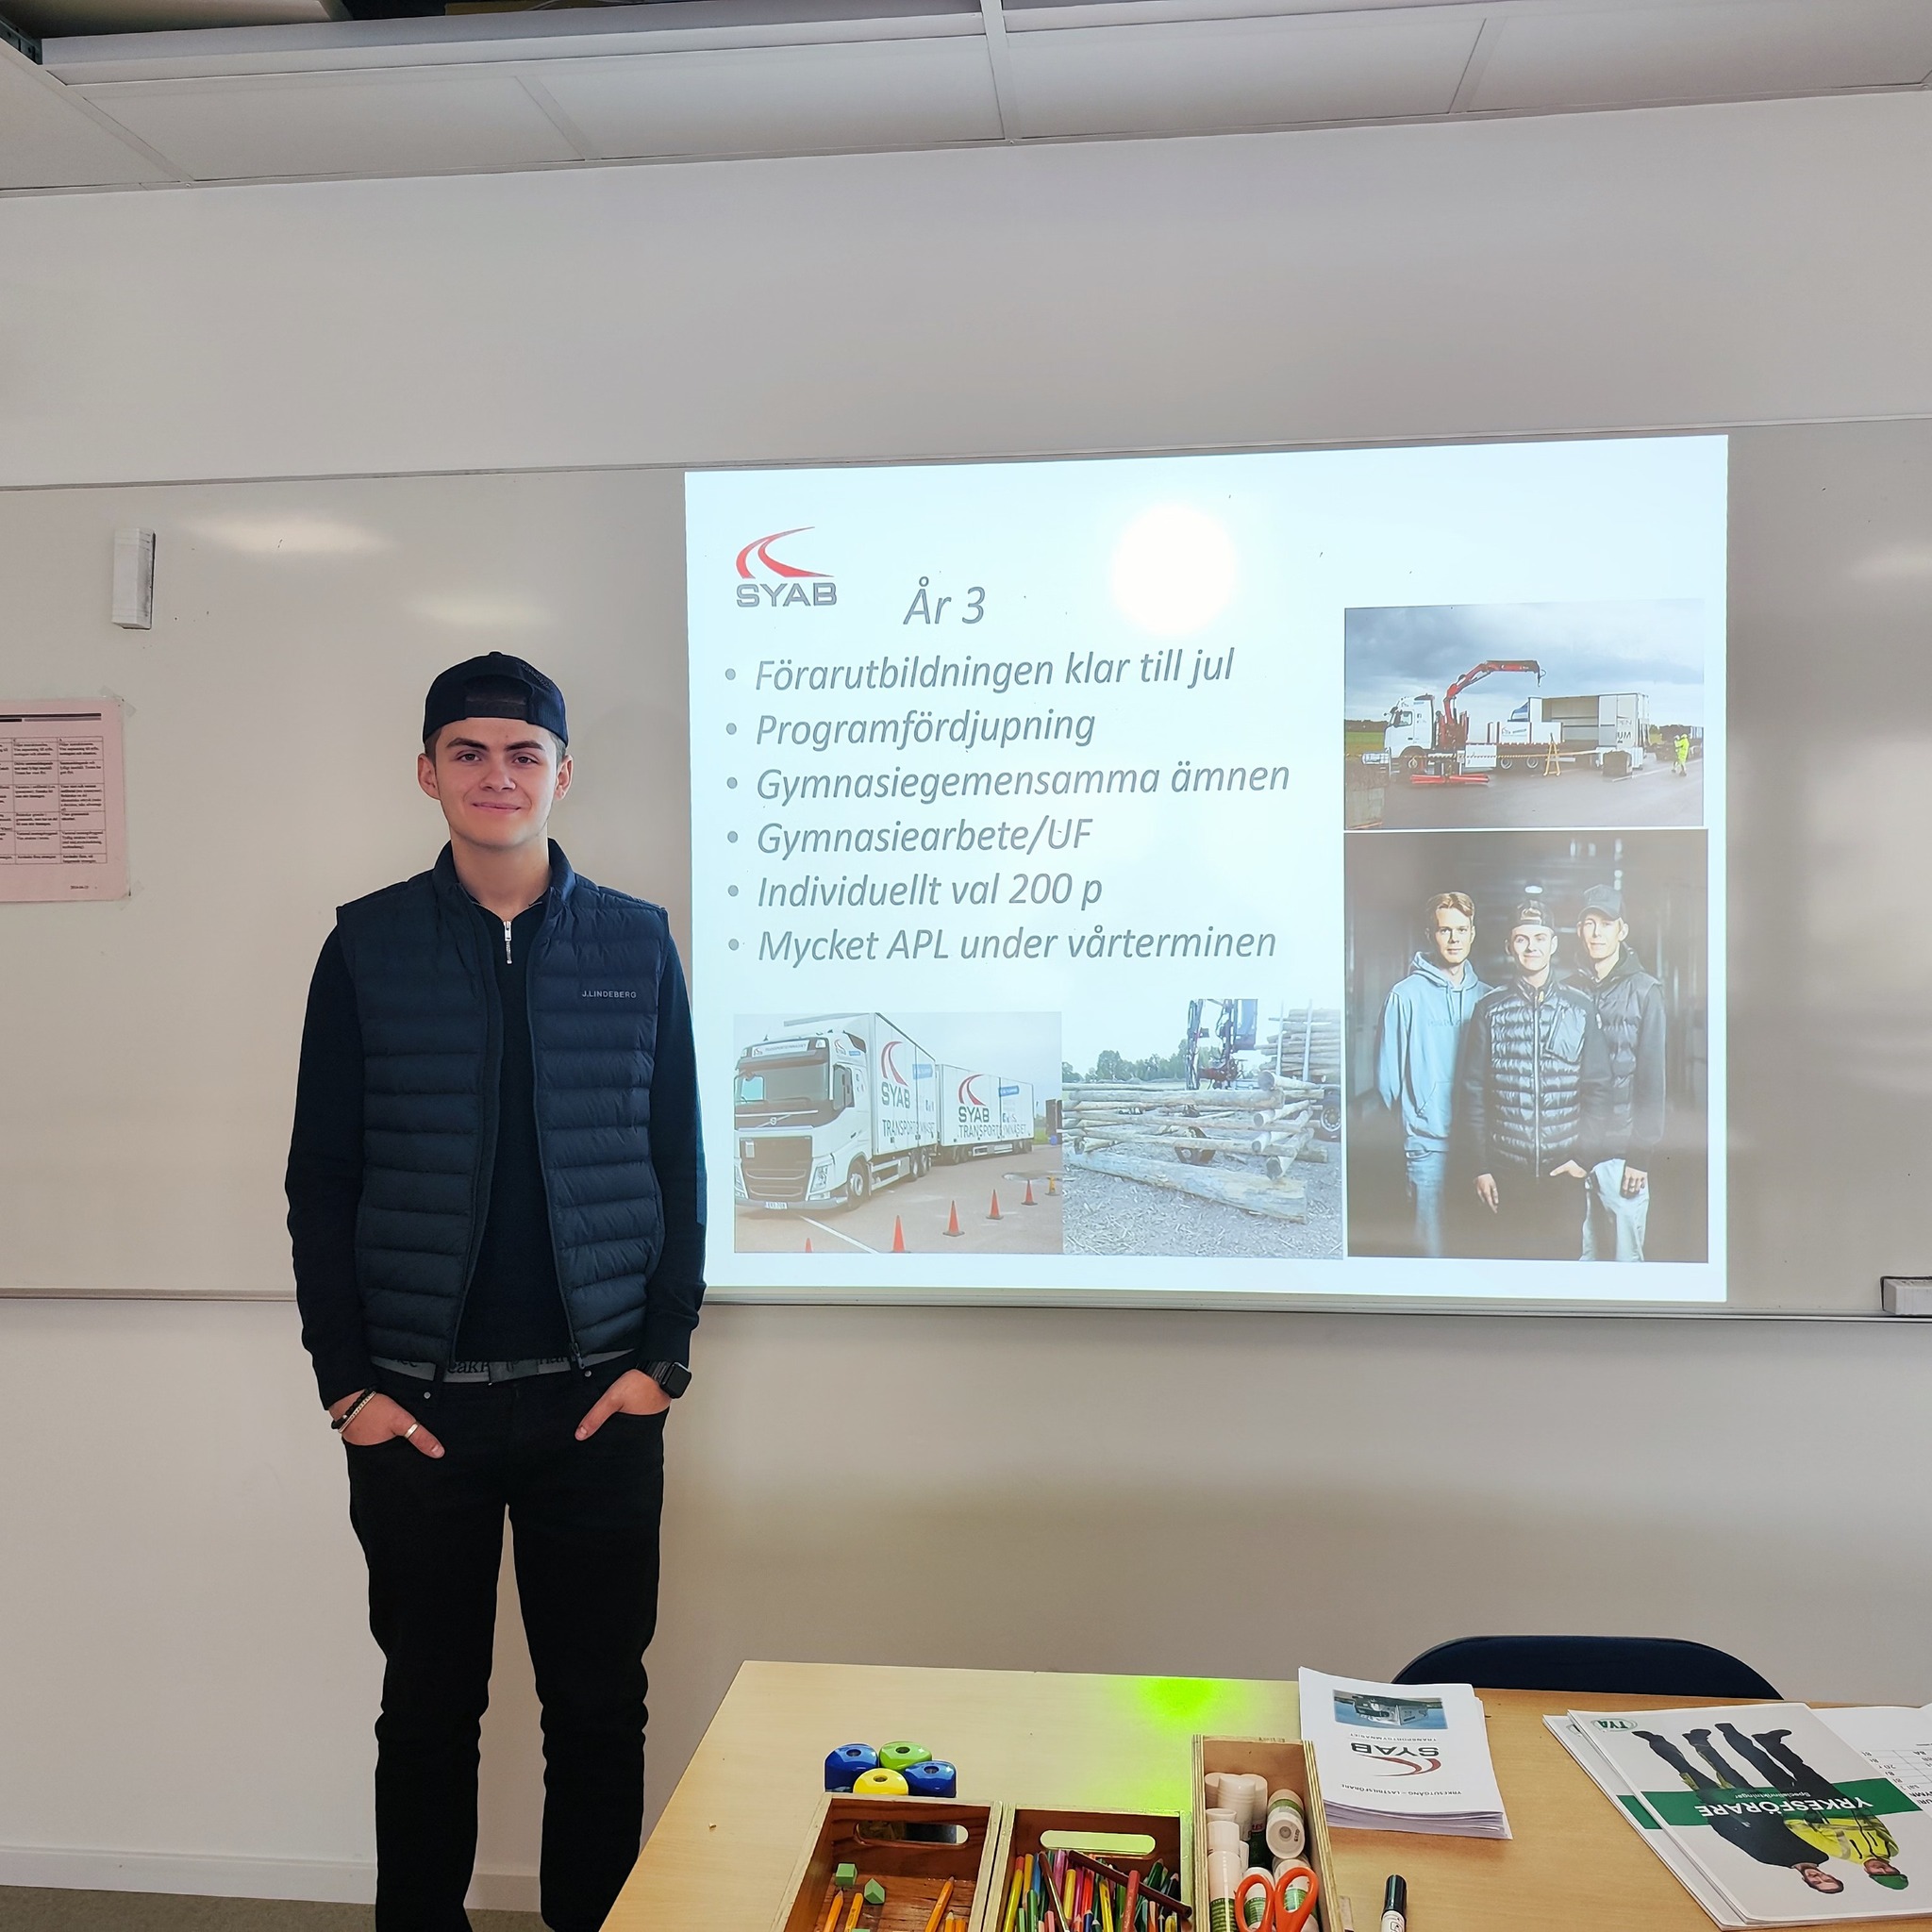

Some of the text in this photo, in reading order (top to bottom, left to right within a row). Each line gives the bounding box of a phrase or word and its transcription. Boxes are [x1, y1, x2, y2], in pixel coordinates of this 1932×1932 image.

[736, 582, 838, 608] SYAB
[903, 576, 986, 625] År 3
[756, 647, 1235, 694] Förarutbildningen klar till jul
[756, 708, 1096, 751] Programfördjupning
[757, 760, 1290, 807] Gymnasiegemensamma ämnen
[758, 815, 1094, 860] Gymnasiearbete/UF
[758, 873, 1103, 912] Individuellt val 200 p
[758, 924, 1276, 969] Mycket APL under vårterminen
[581, 990, 637, 999] J.LINDEBERG
[881, 1081, 910, 1109] SYAB
[958, 1106, 990, 1123] SYAB
[1351, 1742, 1440, 1757] SYAB
[1694, 1796, 1874, 1817] YRKESFÖRARE
